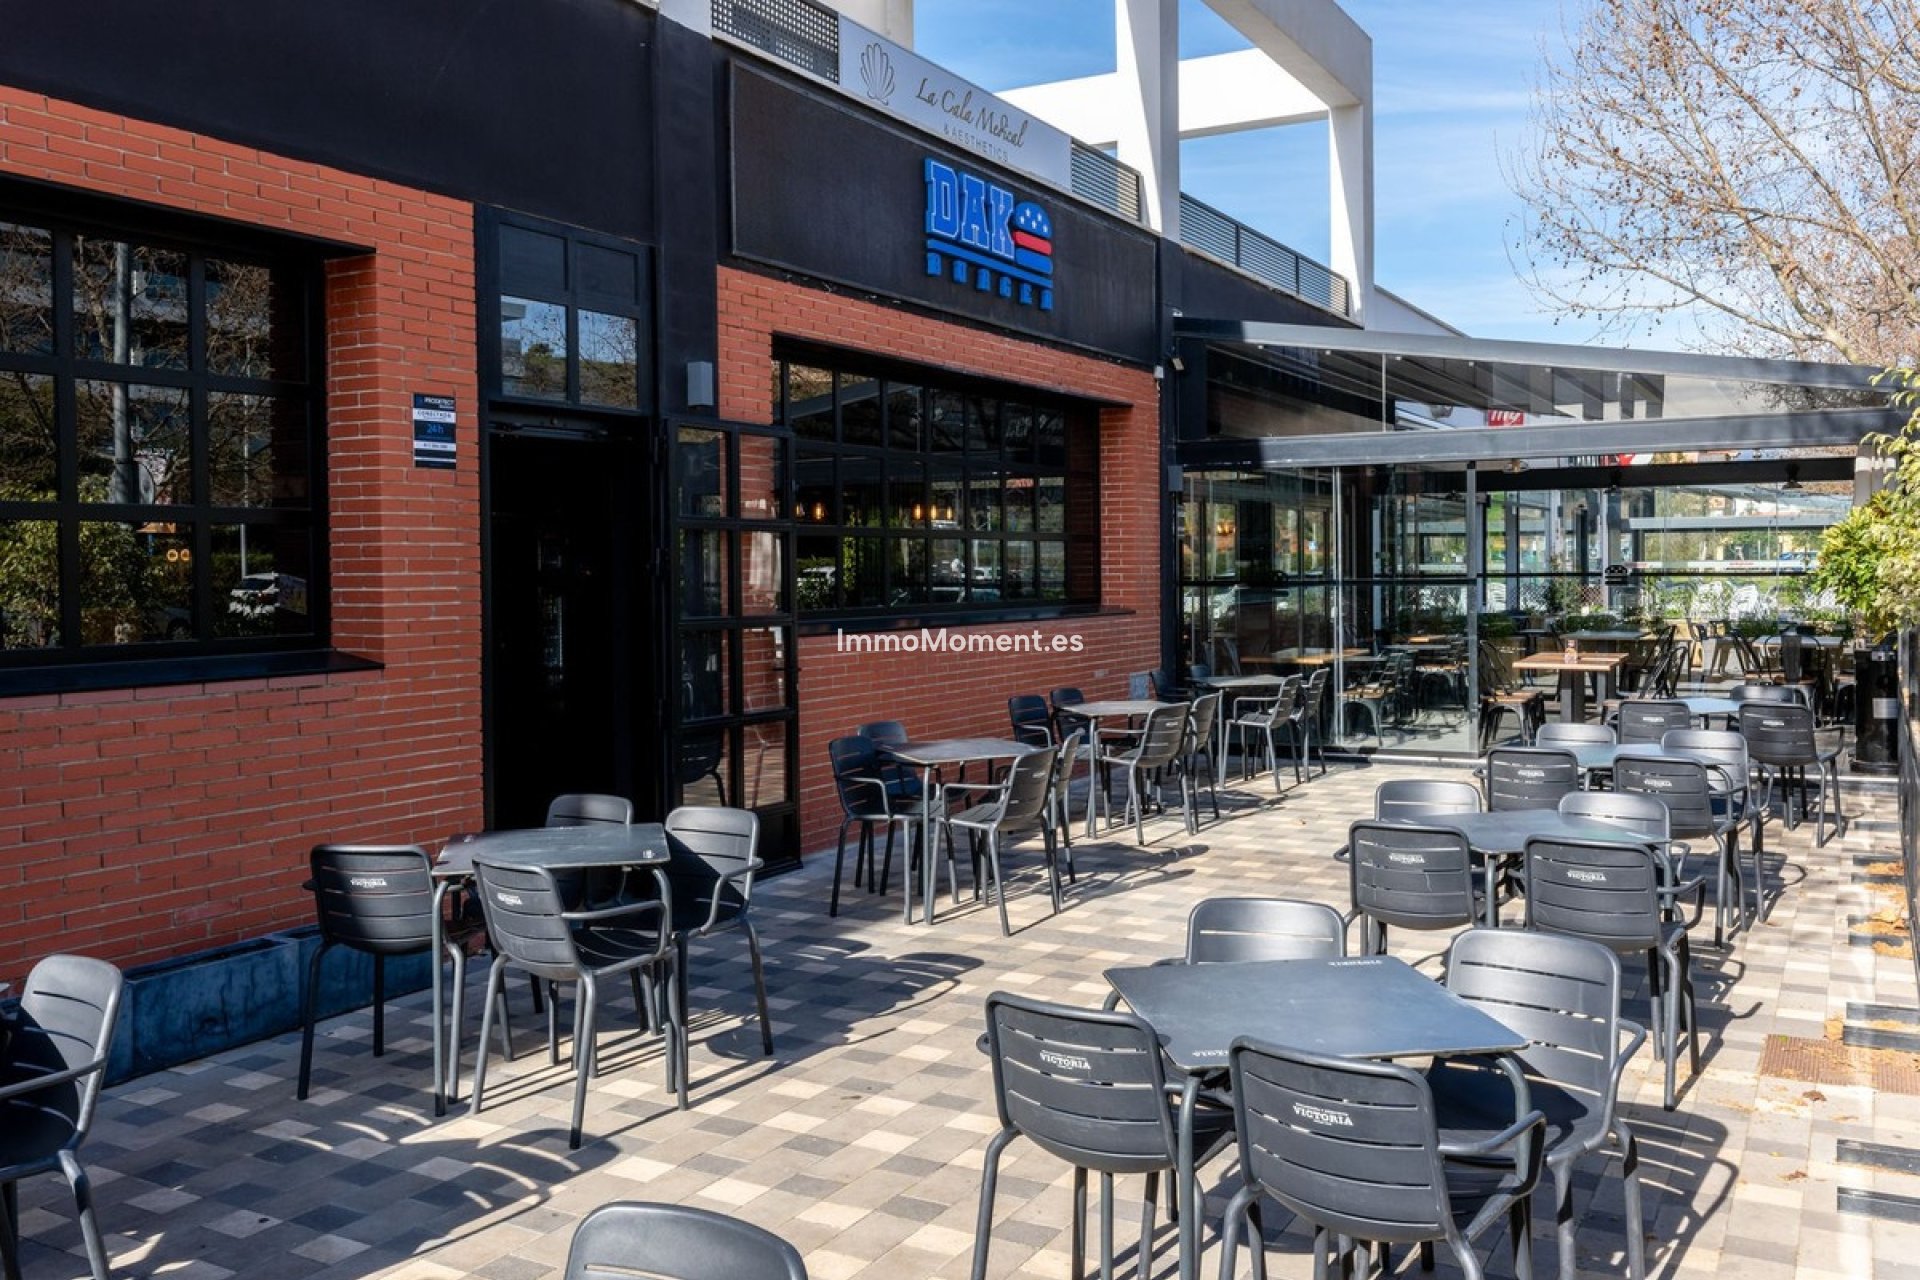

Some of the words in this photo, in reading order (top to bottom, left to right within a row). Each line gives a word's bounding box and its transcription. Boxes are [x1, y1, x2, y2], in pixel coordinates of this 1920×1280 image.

[915, 77, 938, 106] La
[941, 89, 974, 125] Cala
[976, 107, 1028, 148] Medical
[952, 129, 1008, 162] AESTHETICS
[925, 157, 1015, 260] DAK
[1040, 1052, 1091, 1070] VICTORIA
[1292, 1105, 1354, 1126] VICTORIA
